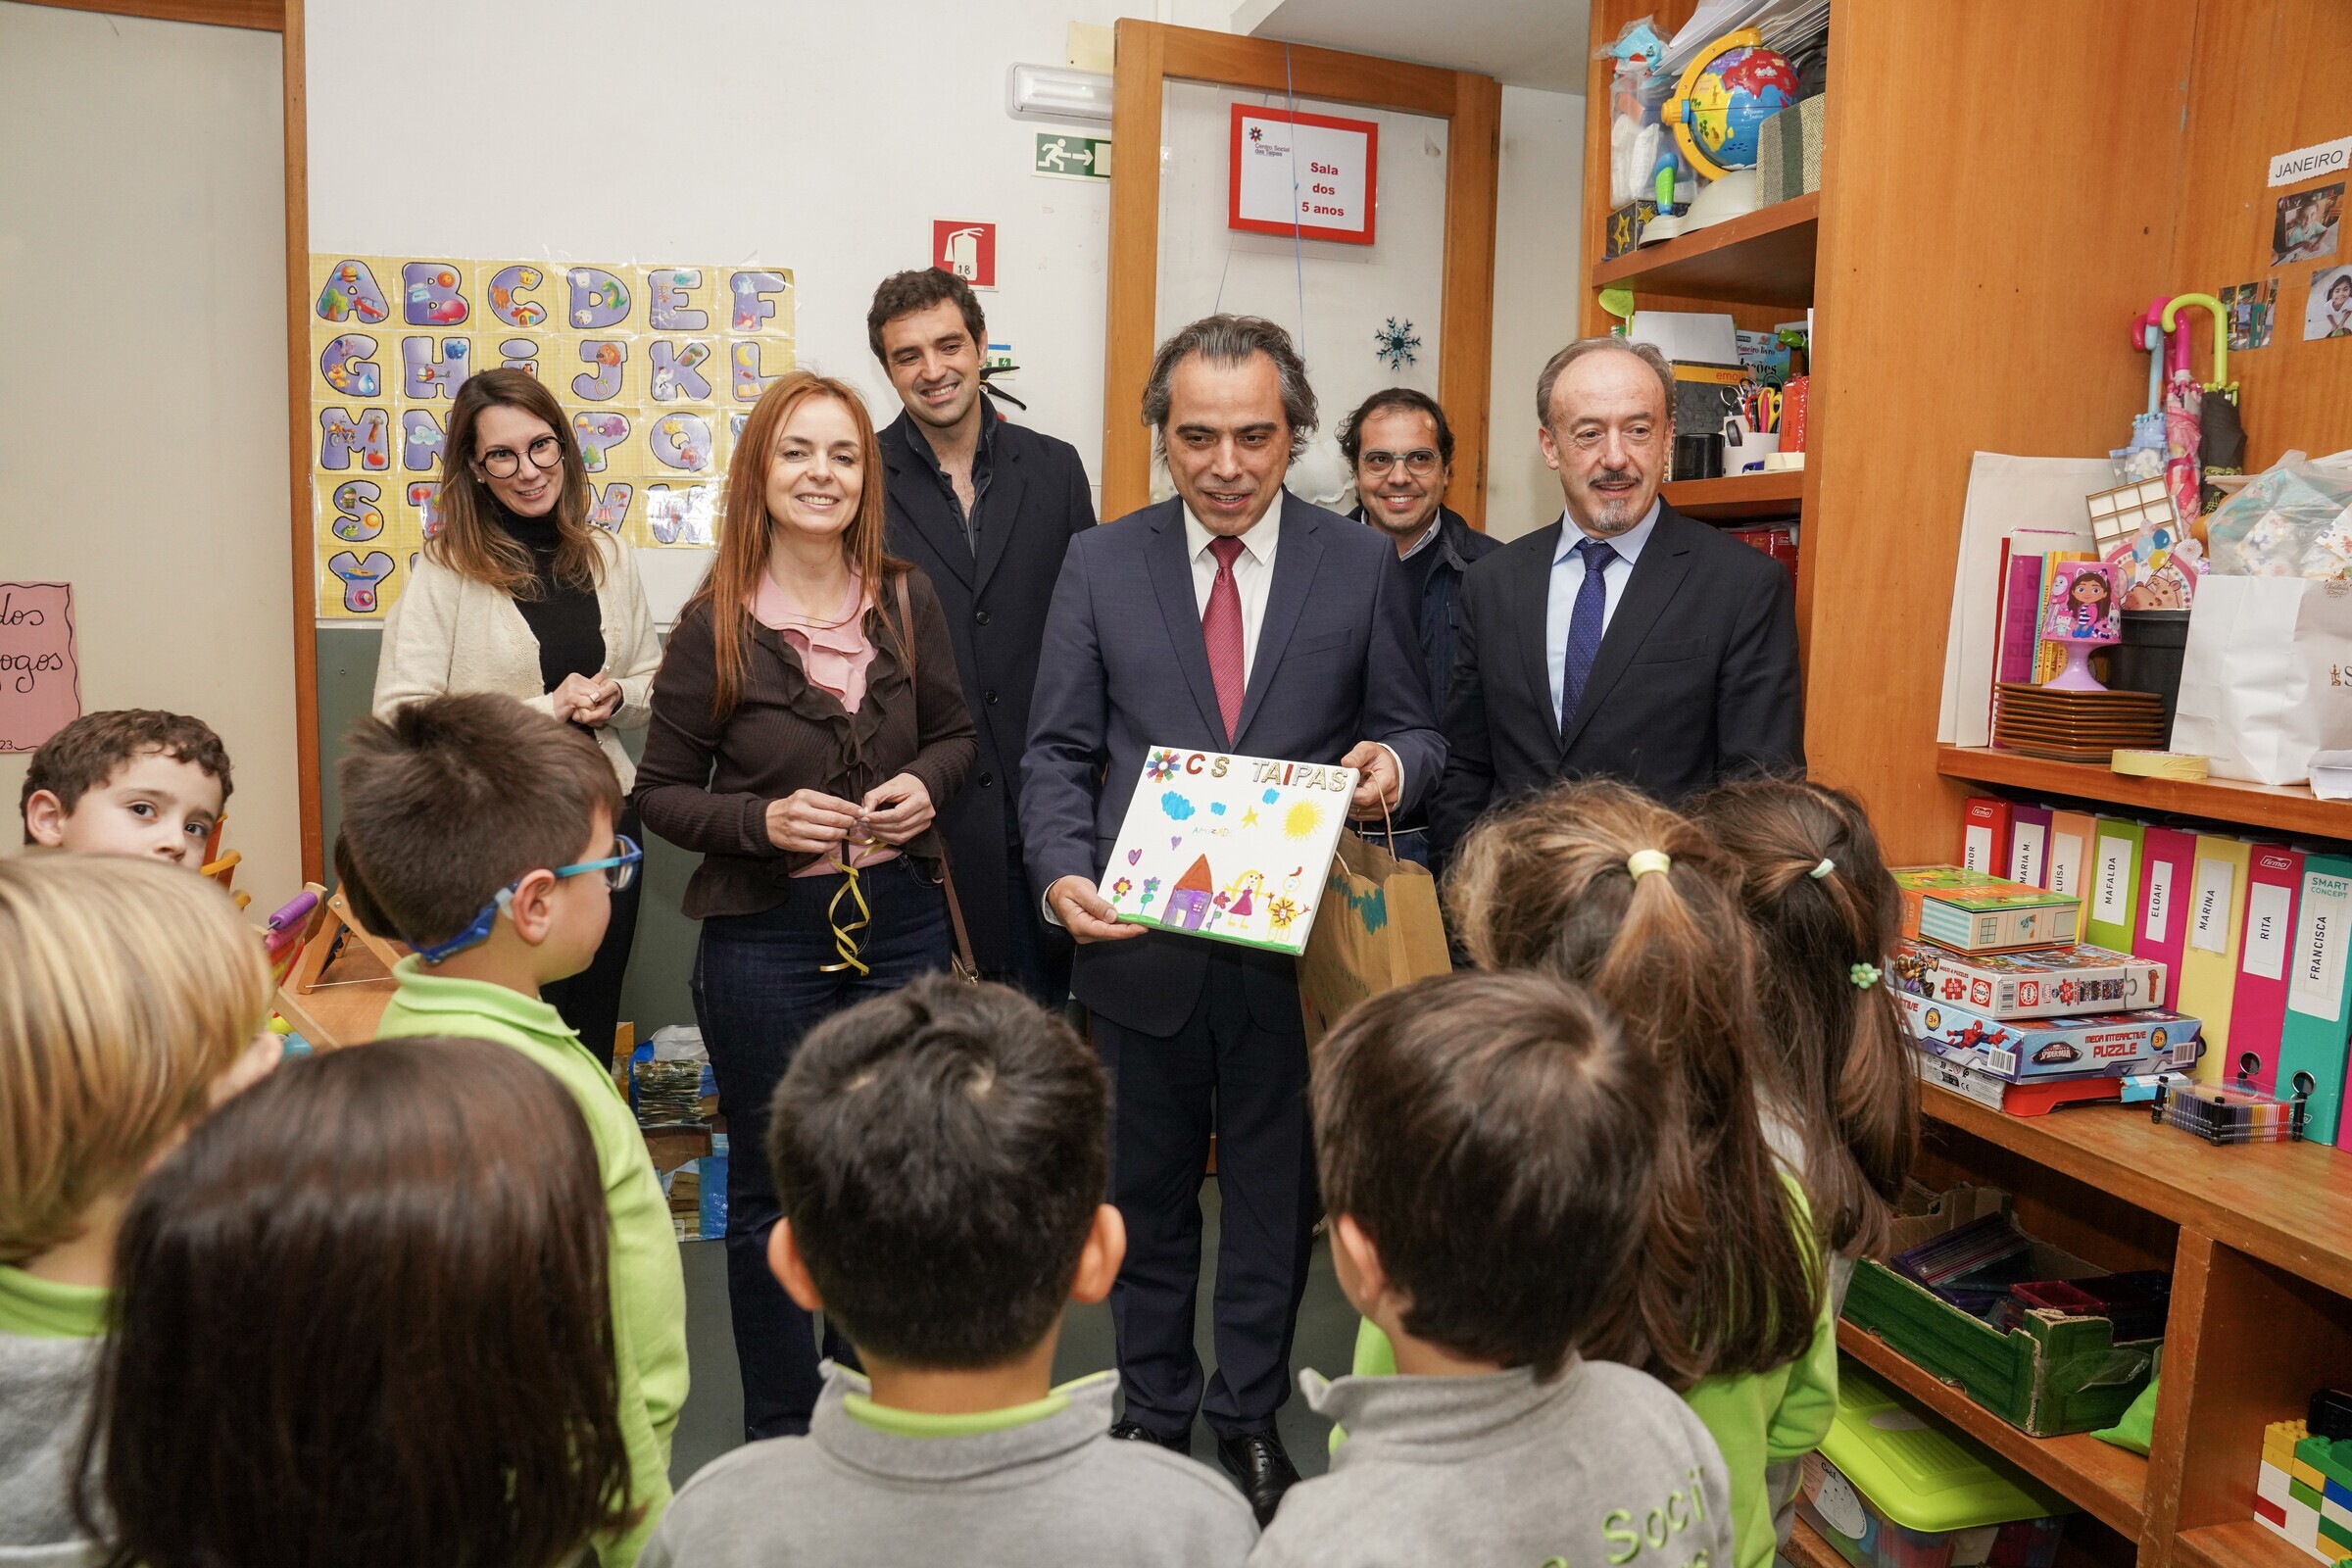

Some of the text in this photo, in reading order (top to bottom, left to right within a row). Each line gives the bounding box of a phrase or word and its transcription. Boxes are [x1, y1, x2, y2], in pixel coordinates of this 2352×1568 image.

[1310, 162, 1339, 175] Sala
[2275, 150, 2343, 178] JANEIRO
[1312, 183, 1335, 195] dos
[1301, 202, 1345, 217] 5 anos
[957, 265, 971, 275] 18
[317, 260, 786, 331] A B C D E F
[1738, 345, 1760, 354] rimeiro
[320, 333, 381, 397] G
[402, 336, 470, 399] H
[571, 339, 628, 401] J
[649, 341, 711, 401] K
[731, 341, 782, 402] L
[319, 407, 390, 471] M
[402, 409, 452, 470] N
[573, 412, 631, 473] P
[650, 412, 711, 473] Q
[332, 479, 384, 542] S
[328, 551, 395, 612] Y
[0, 652, 63, 693] ogos
[1252, 760, 1348, 792] TAIPAS
[2019, 841, 2032, 884] MARIA M.
[2055, 864, 2064, 892] LUÍSA
[2104, 858, 2117, 905] MAFALDA
[2312, 877, 2349, 891] SMART
[2151, 884, 2162, 918] ELOAH
[2310, 887, 2348, 899] CONCEPT
[2198, 889, 2216, 930] MARINA
[2260, 916, 2272, 941] RITA
[2309, 916, 2327, 981] FRANCISCA
[1902, 999, 1919, 1012] TIVE
[2084, 1031, 2147, 1044] MEGA INTERACTIVE
[2092, 1043, 2137, 1059] PUZZLE
[2154, 1035, 2164, 1044] 3+
